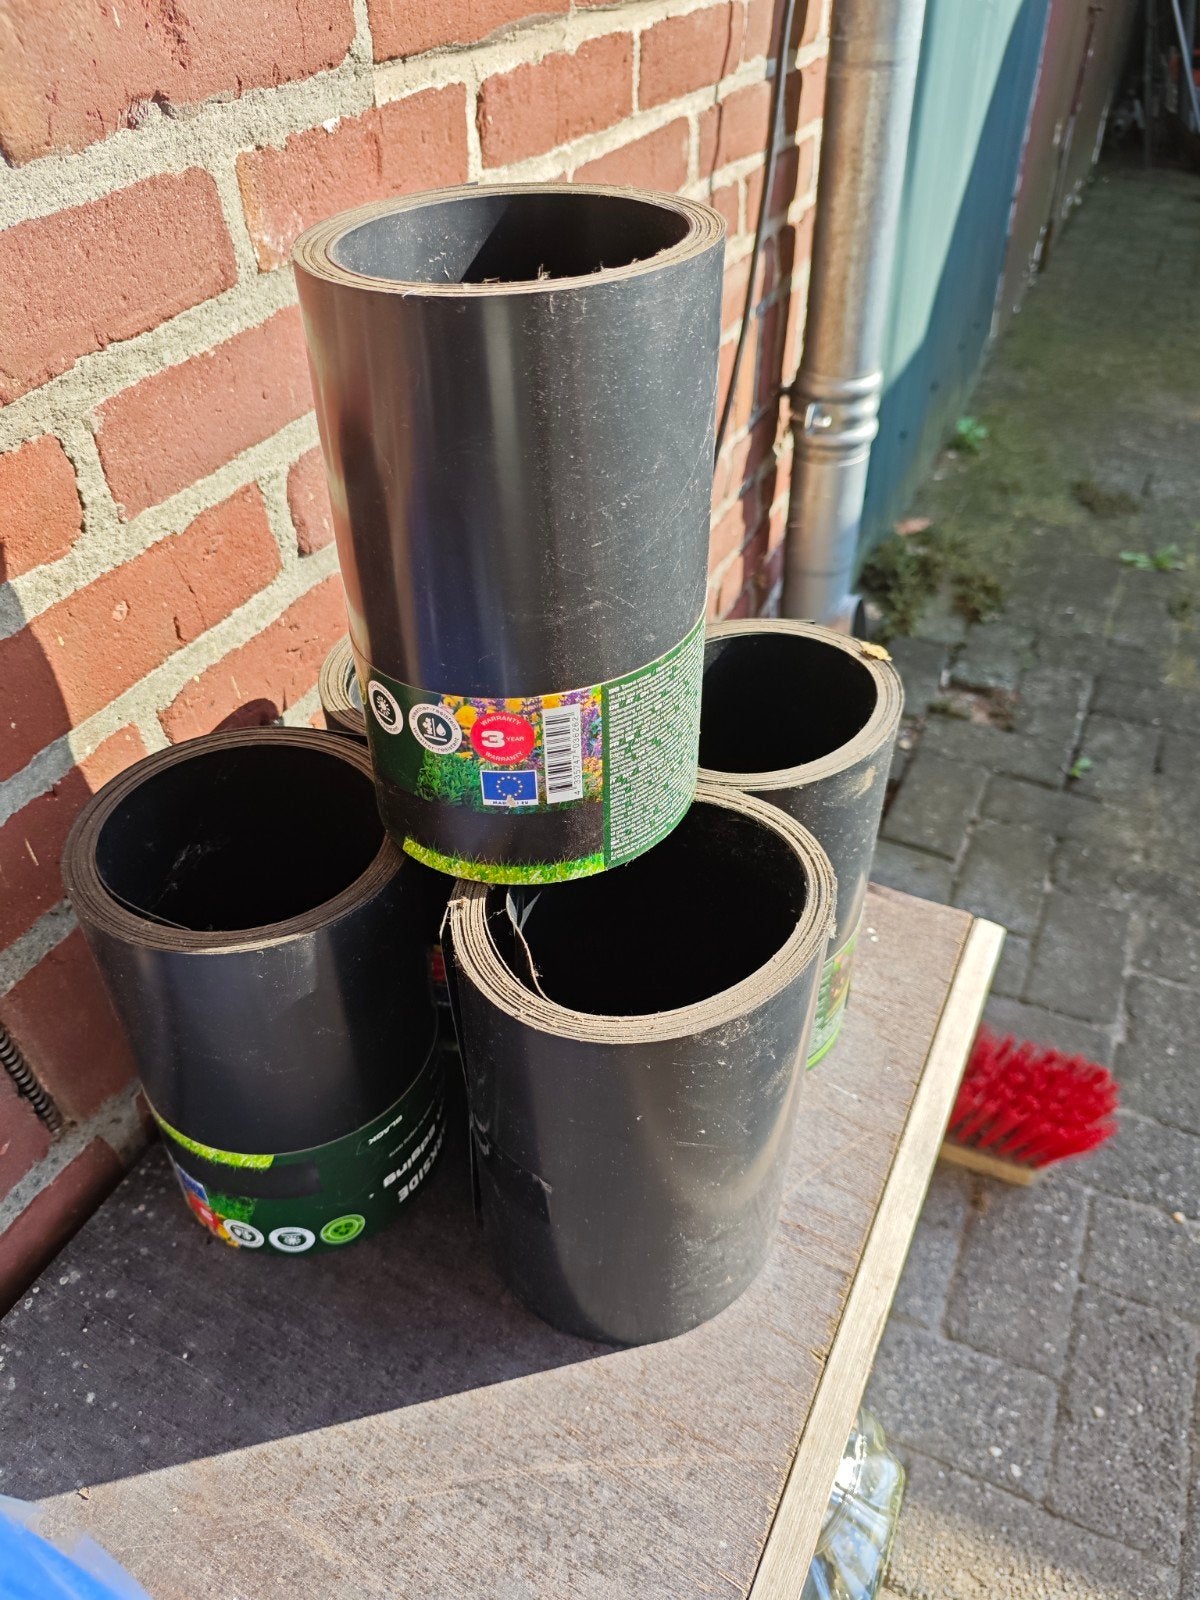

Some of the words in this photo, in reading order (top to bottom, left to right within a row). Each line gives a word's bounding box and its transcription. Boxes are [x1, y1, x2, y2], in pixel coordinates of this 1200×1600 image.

[480, 715, 522, 726] WARRANTY
[480, 730, 506, 748] 3
[485, 750, 524, 762] WARRANTY
[368, 1115, 403, 1146] BLACK
